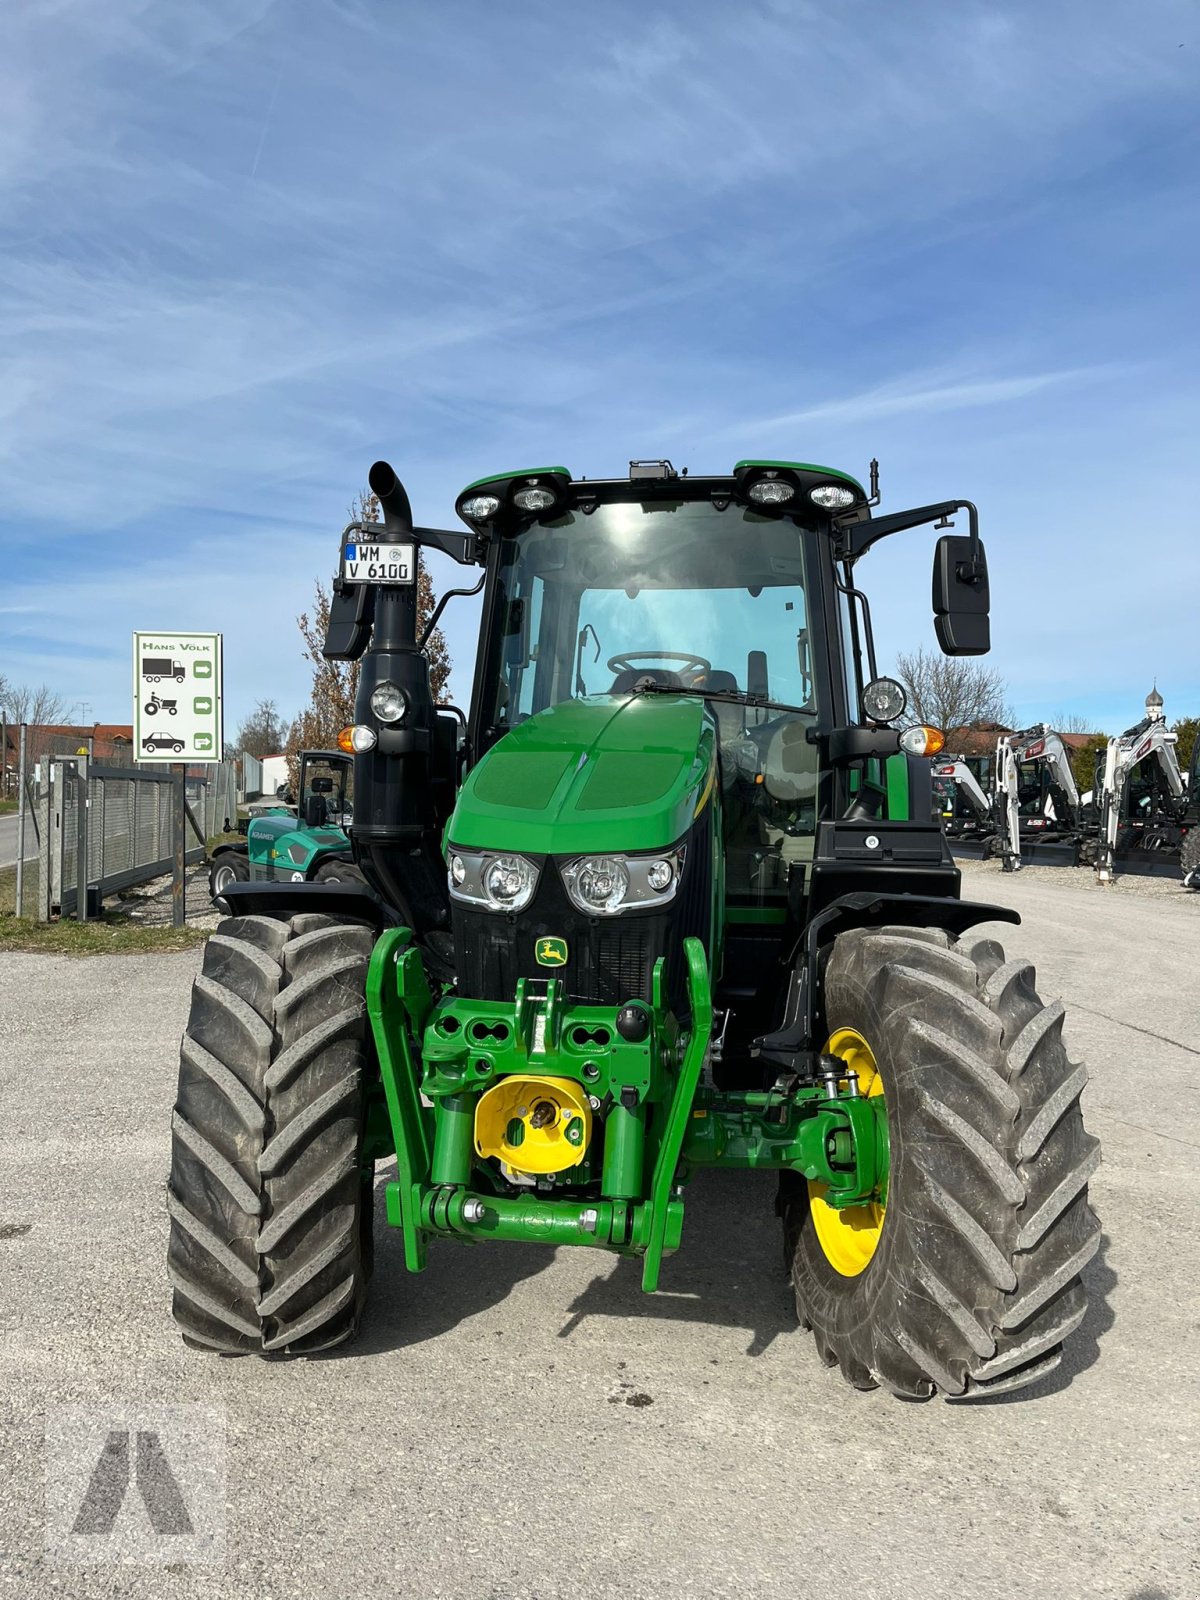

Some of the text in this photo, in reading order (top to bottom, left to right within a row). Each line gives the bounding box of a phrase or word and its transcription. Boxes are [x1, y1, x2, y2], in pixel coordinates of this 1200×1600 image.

[359, 546, 380, 562] WM
[350, 563, 408, 579] V 6100
[251, 831, 275, 841] KRAMER
